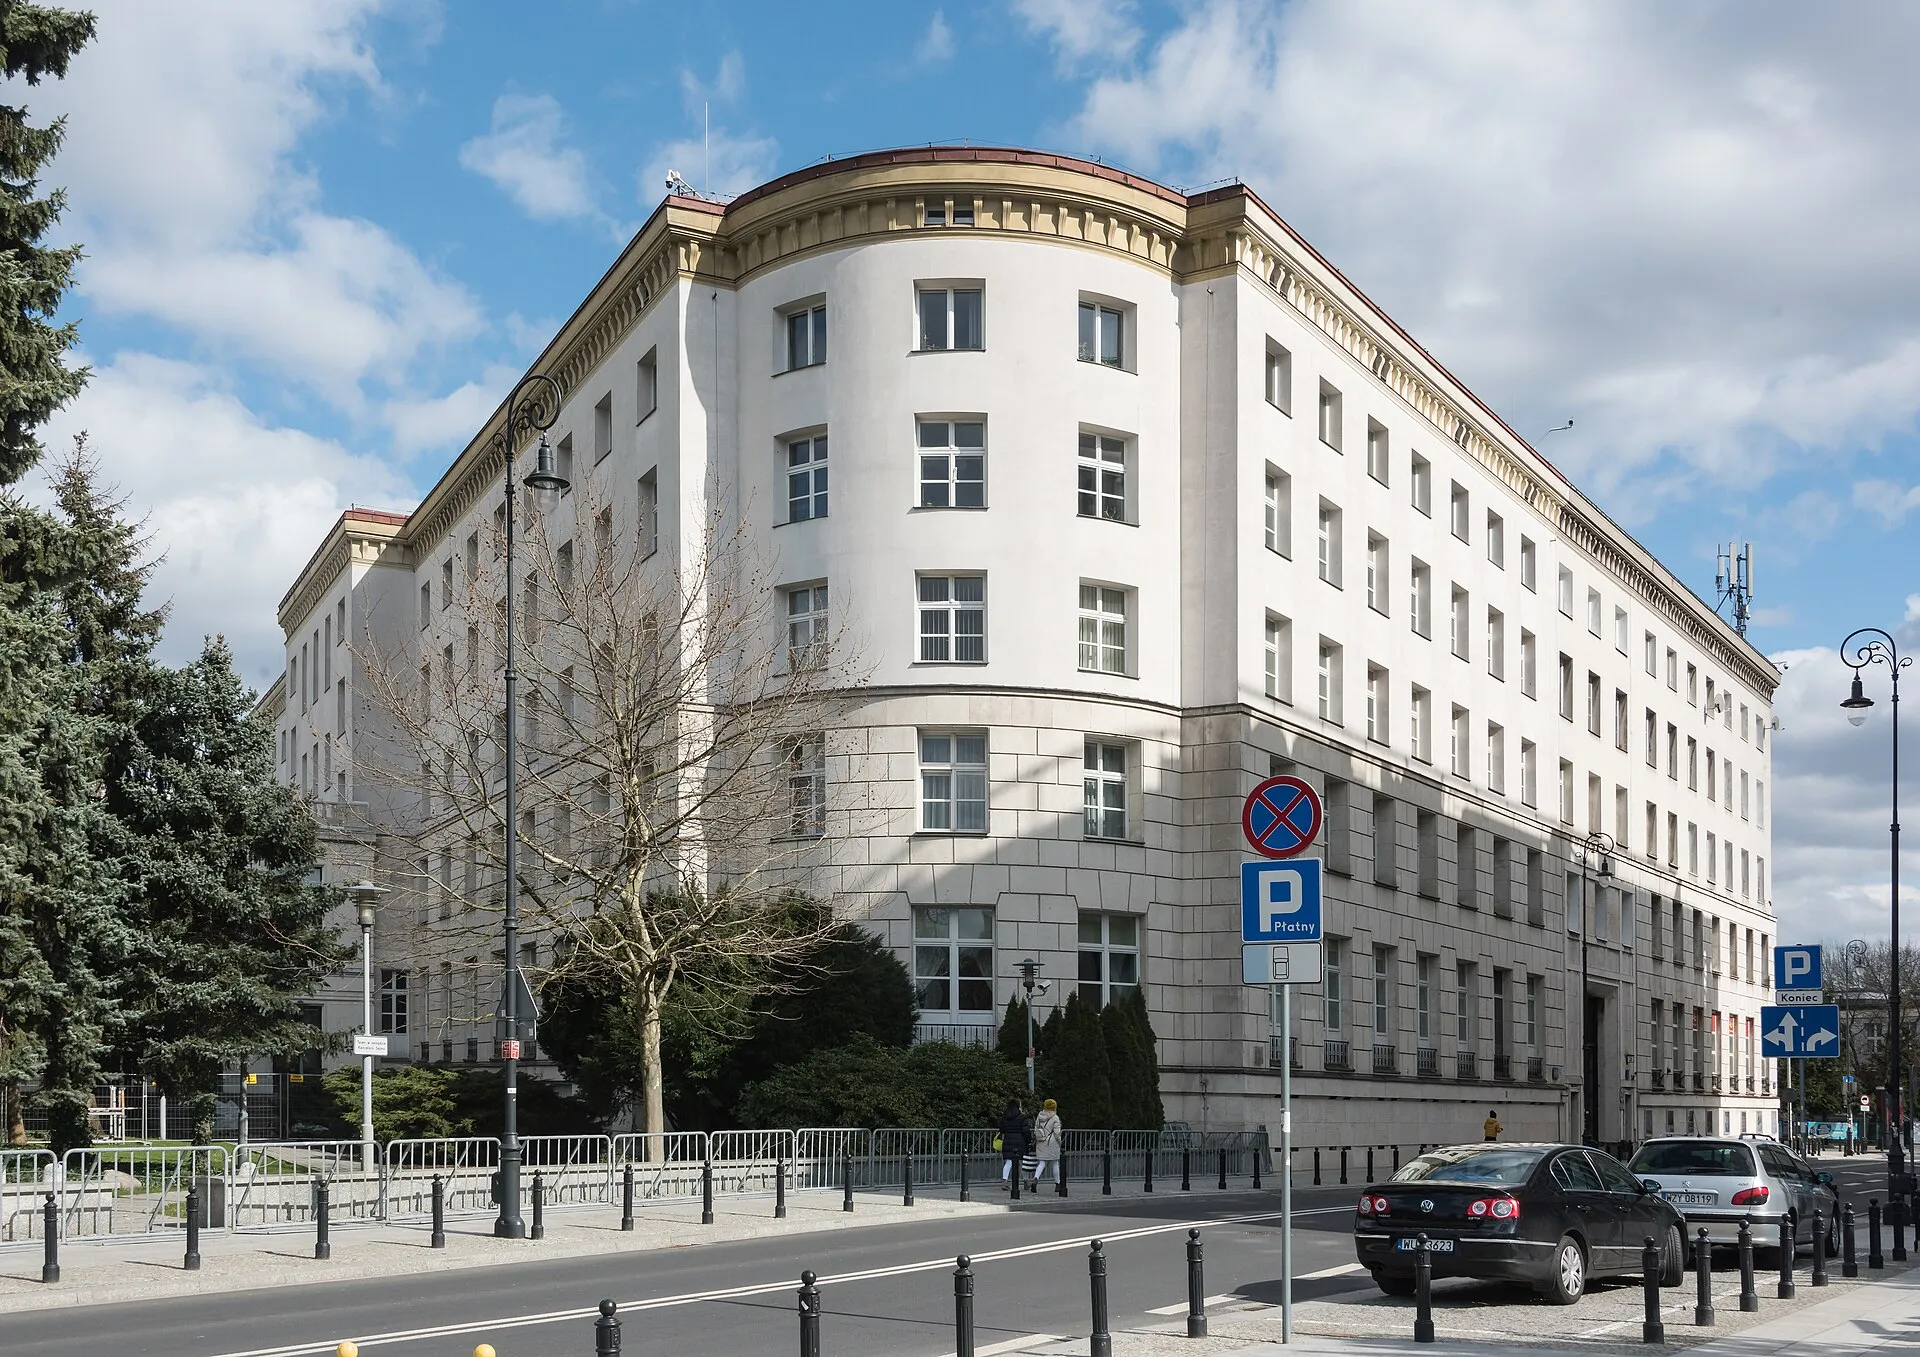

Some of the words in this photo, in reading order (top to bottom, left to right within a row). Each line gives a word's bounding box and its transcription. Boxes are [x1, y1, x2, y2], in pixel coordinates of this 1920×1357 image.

[1258, 869, 1303, 933] P
[1274, 921, 1315, 935] Płatny
[1784, 950, 1811, 985] P
[1781, 993, 1818, 1002] Koniec
[1667, 1193, 1683, 1203] WZY
[1685, 1194, 1712, 1204] 08119
